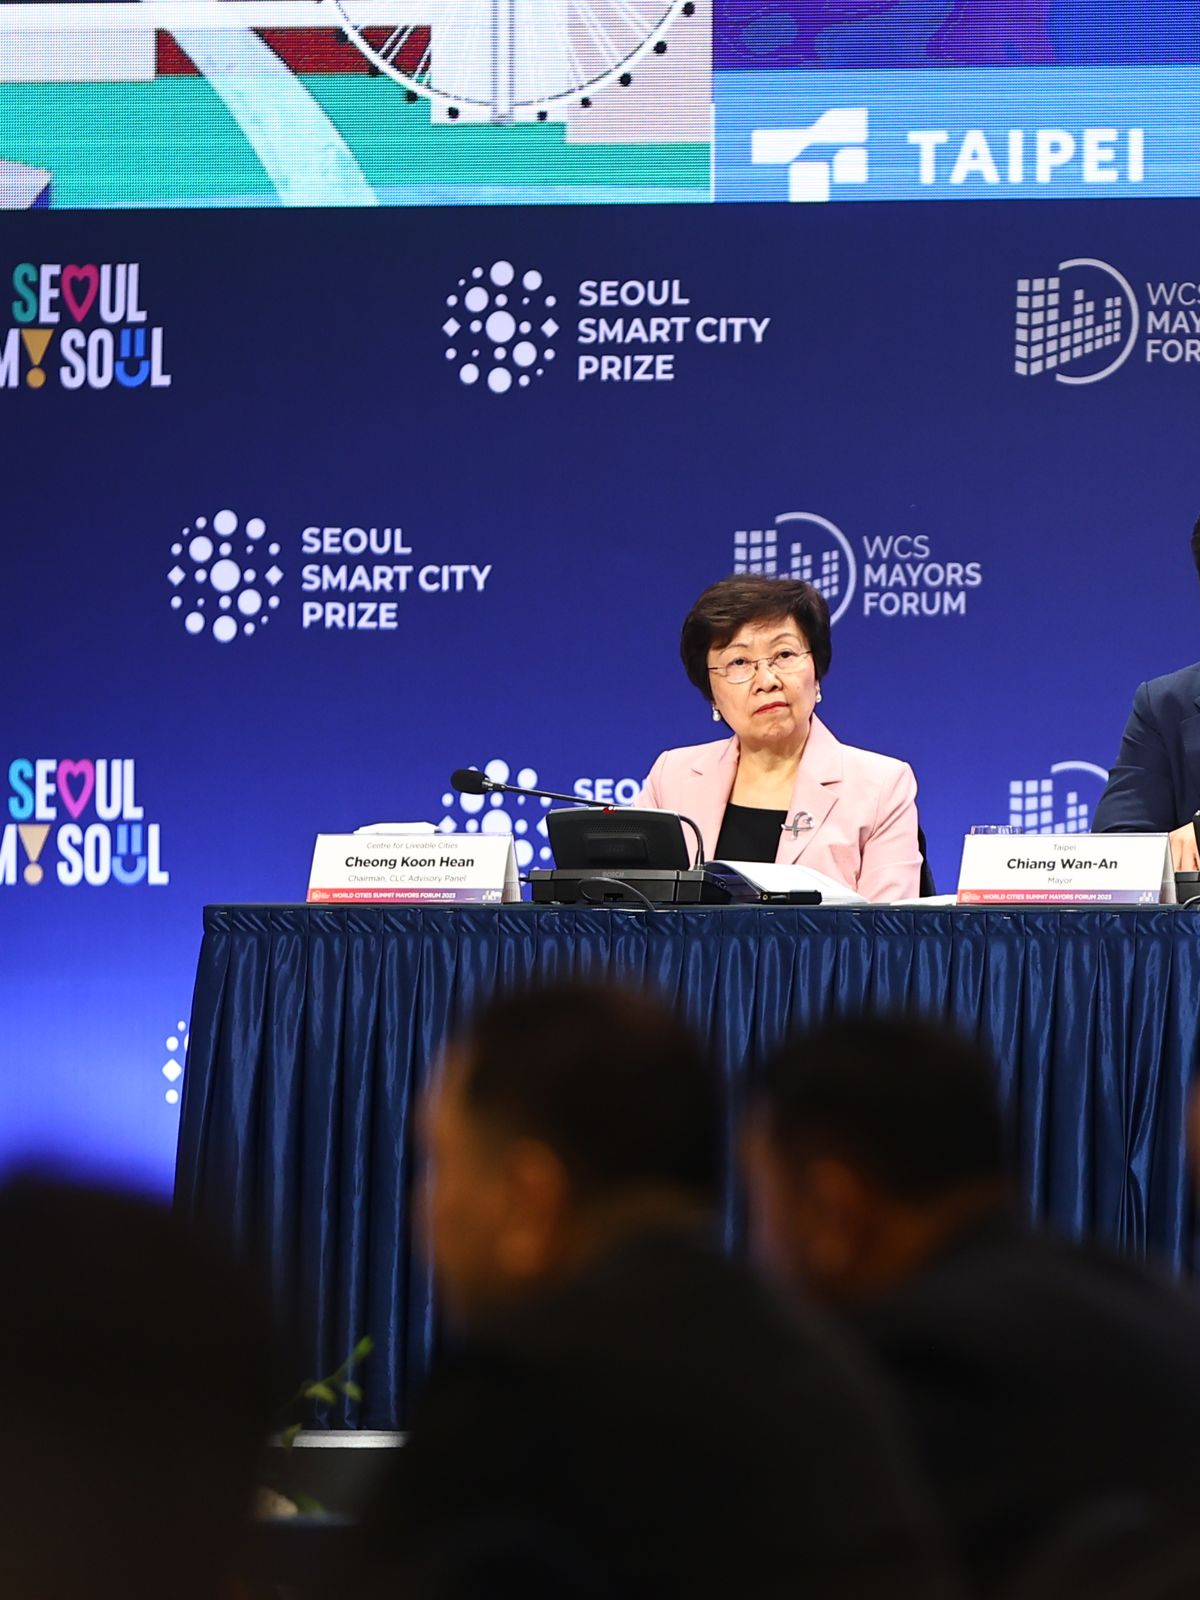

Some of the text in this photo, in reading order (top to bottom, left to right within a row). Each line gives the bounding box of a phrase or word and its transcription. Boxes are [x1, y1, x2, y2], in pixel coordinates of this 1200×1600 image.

[907, 128, 1145, 185] TAIPEI
[578, 279, 690, 306] SEOUL
[577, 316, 771, 344] SMART CITY
[60, 327, 172, 390] SOUL
[577, 354, 675, 381] PRIZE
[302, 526, 412, 555] SEOUL
[863, 534, 930, 559] WCS
[301, 564, 492, 592] SMART CITY
[863, 562, 983, 587] MAYORS
[302, 601, 398, 629] PRIZE
[863, 591, 966, 616] FORUM
[56, 822, 170, 887] SOUL
[366, 841, 459, 850] Centre for Liveable Cities
[1053, 843, 1077, 852] Taipei
[344, 856, 475, 870] Cheong Koon Hean
[1007, 858, 1118, 871] Chiang Wan-An
[389, 874, 406, 883] CLC
[407, 874, 442, 884] Advisory
[444, 874, 467, 883] Panel
[1047, 876, 1073, 885] Mayor
